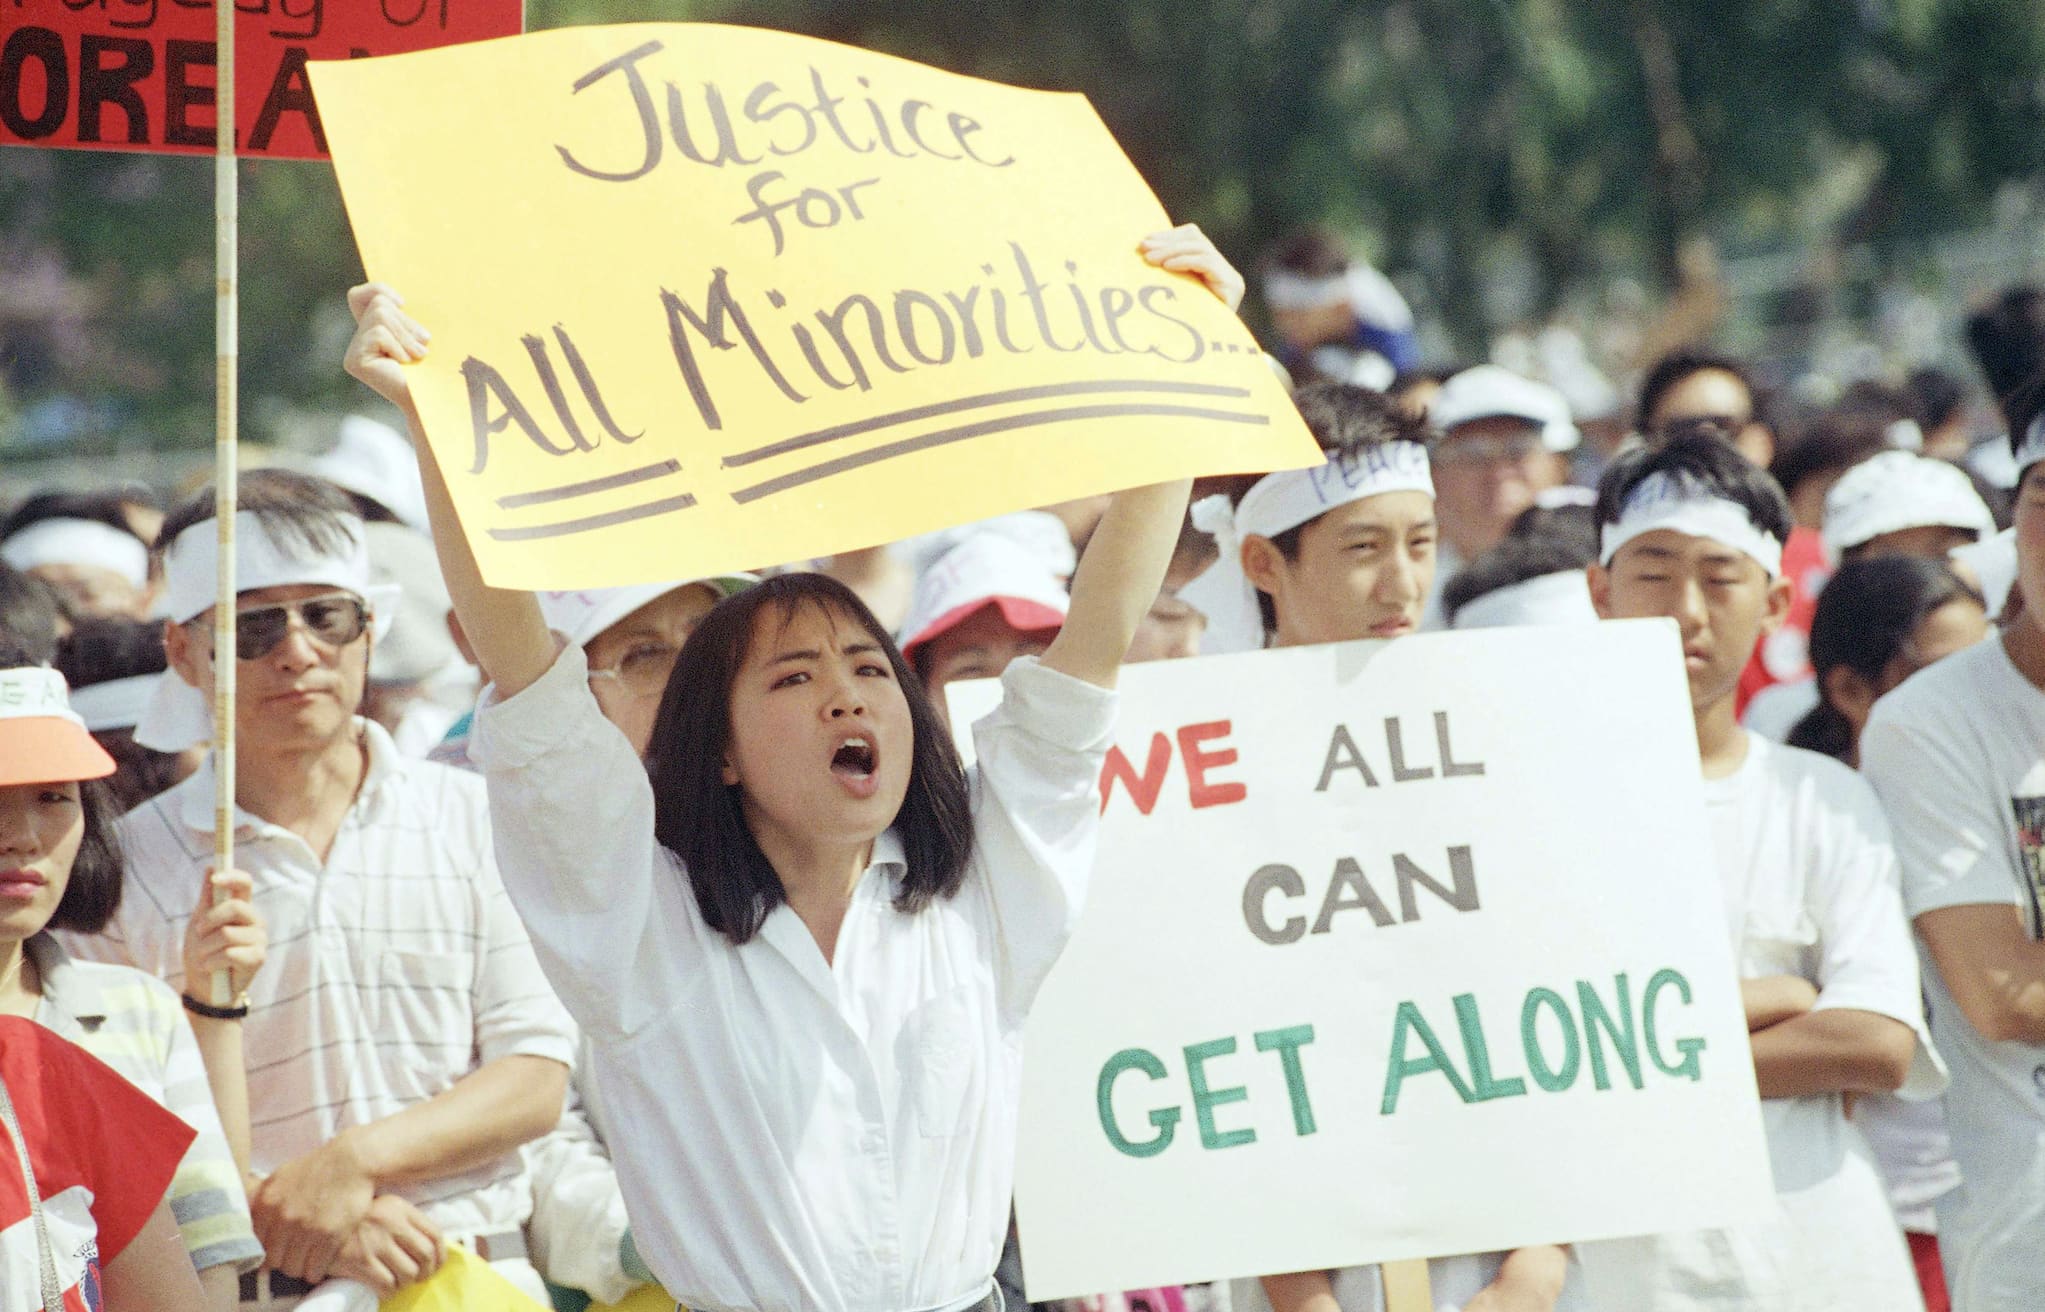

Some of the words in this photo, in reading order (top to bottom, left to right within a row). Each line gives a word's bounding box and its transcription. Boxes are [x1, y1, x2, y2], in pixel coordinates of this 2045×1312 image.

[554, 40, 1016, 182] Justice
[731, 170, 881, 257] for
[460, 323, 646, 474] All
[1314, 711, 1485, 792] ALL
[1242, 845, 1481, 946] CAN
[1096, 1023, 1318, 1158] GET
[1379, 968, 1707, 1116] ALONG
